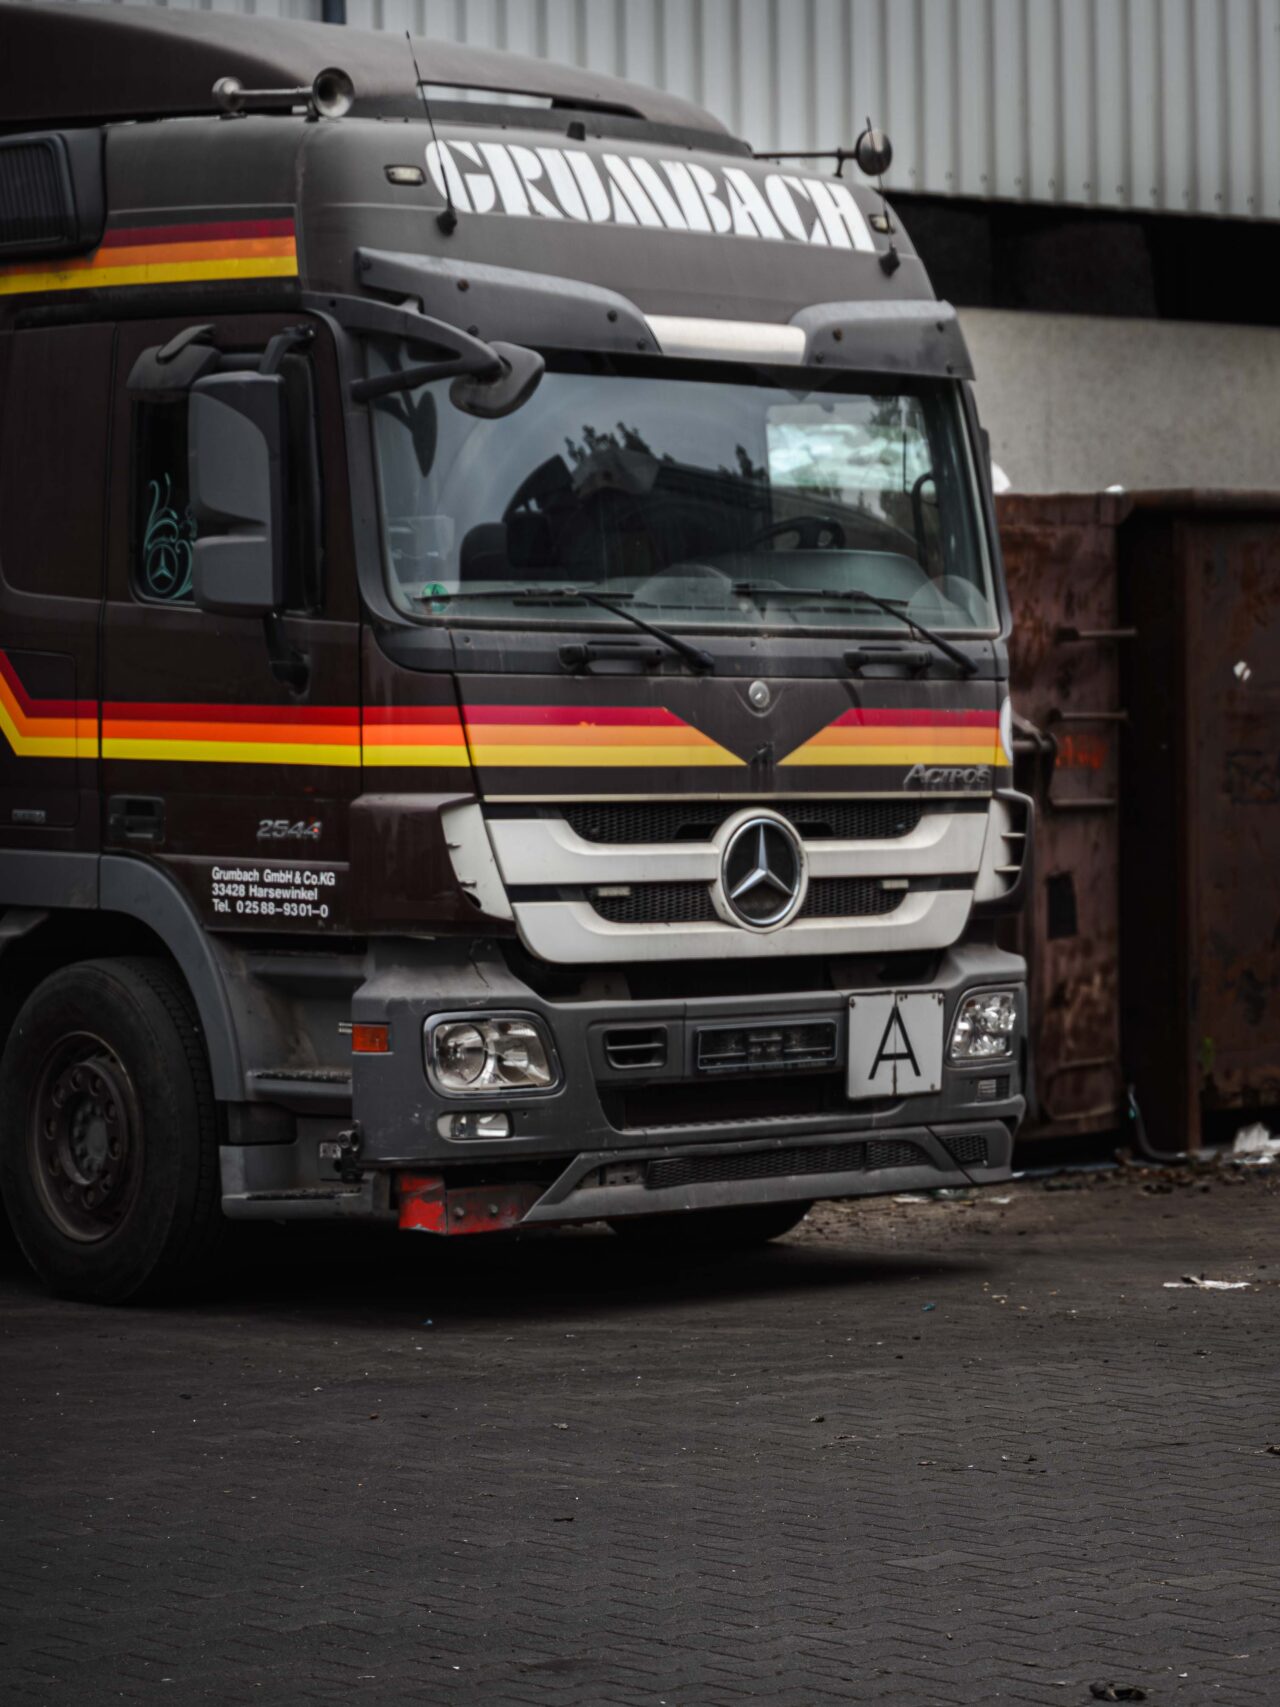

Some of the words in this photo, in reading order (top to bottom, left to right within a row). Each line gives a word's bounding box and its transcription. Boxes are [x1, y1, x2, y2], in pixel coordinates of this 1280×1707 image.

[425, 140, 876, 252] GRUMBACH
[256, 819, 322, 839] 2544
[211, 866, 260, 882] Grumbach
[263, 868, 293, 883] GmbH
[212, 882, 246, 898] 33428
[249, 884, 318, 901] Harsewinkel
[212, 898, 231, 912] Tel.
[868, 1005, 921, 1080] A
